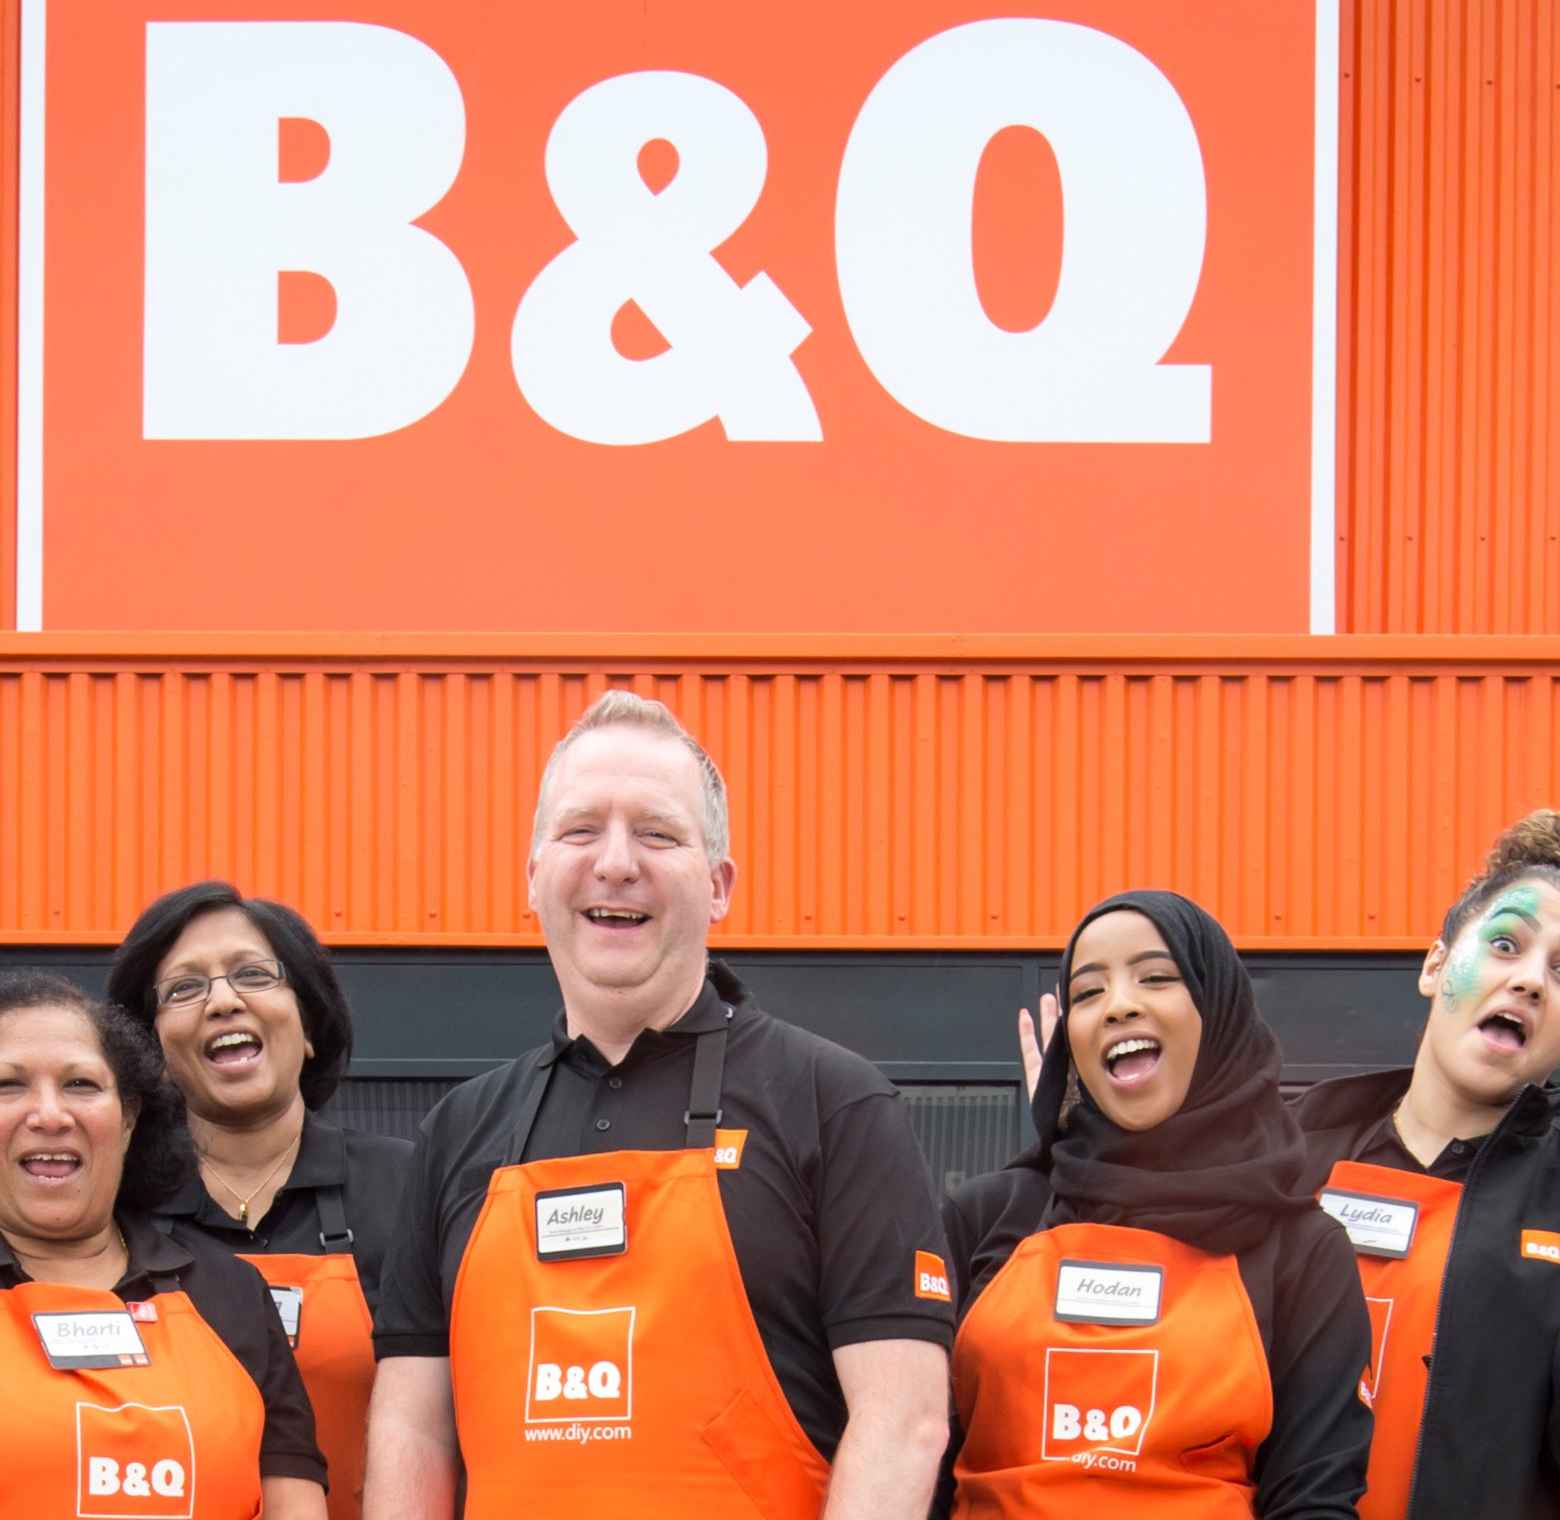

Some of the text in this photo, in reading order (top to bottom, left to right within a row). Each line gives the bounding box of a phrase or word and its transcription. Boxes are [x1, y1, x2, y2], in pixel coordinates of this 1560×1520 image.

[142, 16, 1212, 446] B&Q
[714, 1147, 737, 1164] &Q
[546, 1204, 604, 1226] Ashley
[1339, 1203, 1393, 1224] Lydia
[920, 1272, 950, 1296] B&Q
[1076, 1278, 1142, 1297] Hodan
[56, 1320, 121, 1338] Bharti
[534, 1360, 621, 1401] B&Q
[1052, 1403, 1142, 1441] B&Q
[524, 1422, 632, 1445] www.diy.com
[1070, 1451, 1137, 1472] diy.com
[88, 1456, 185, 1497] B&Q
